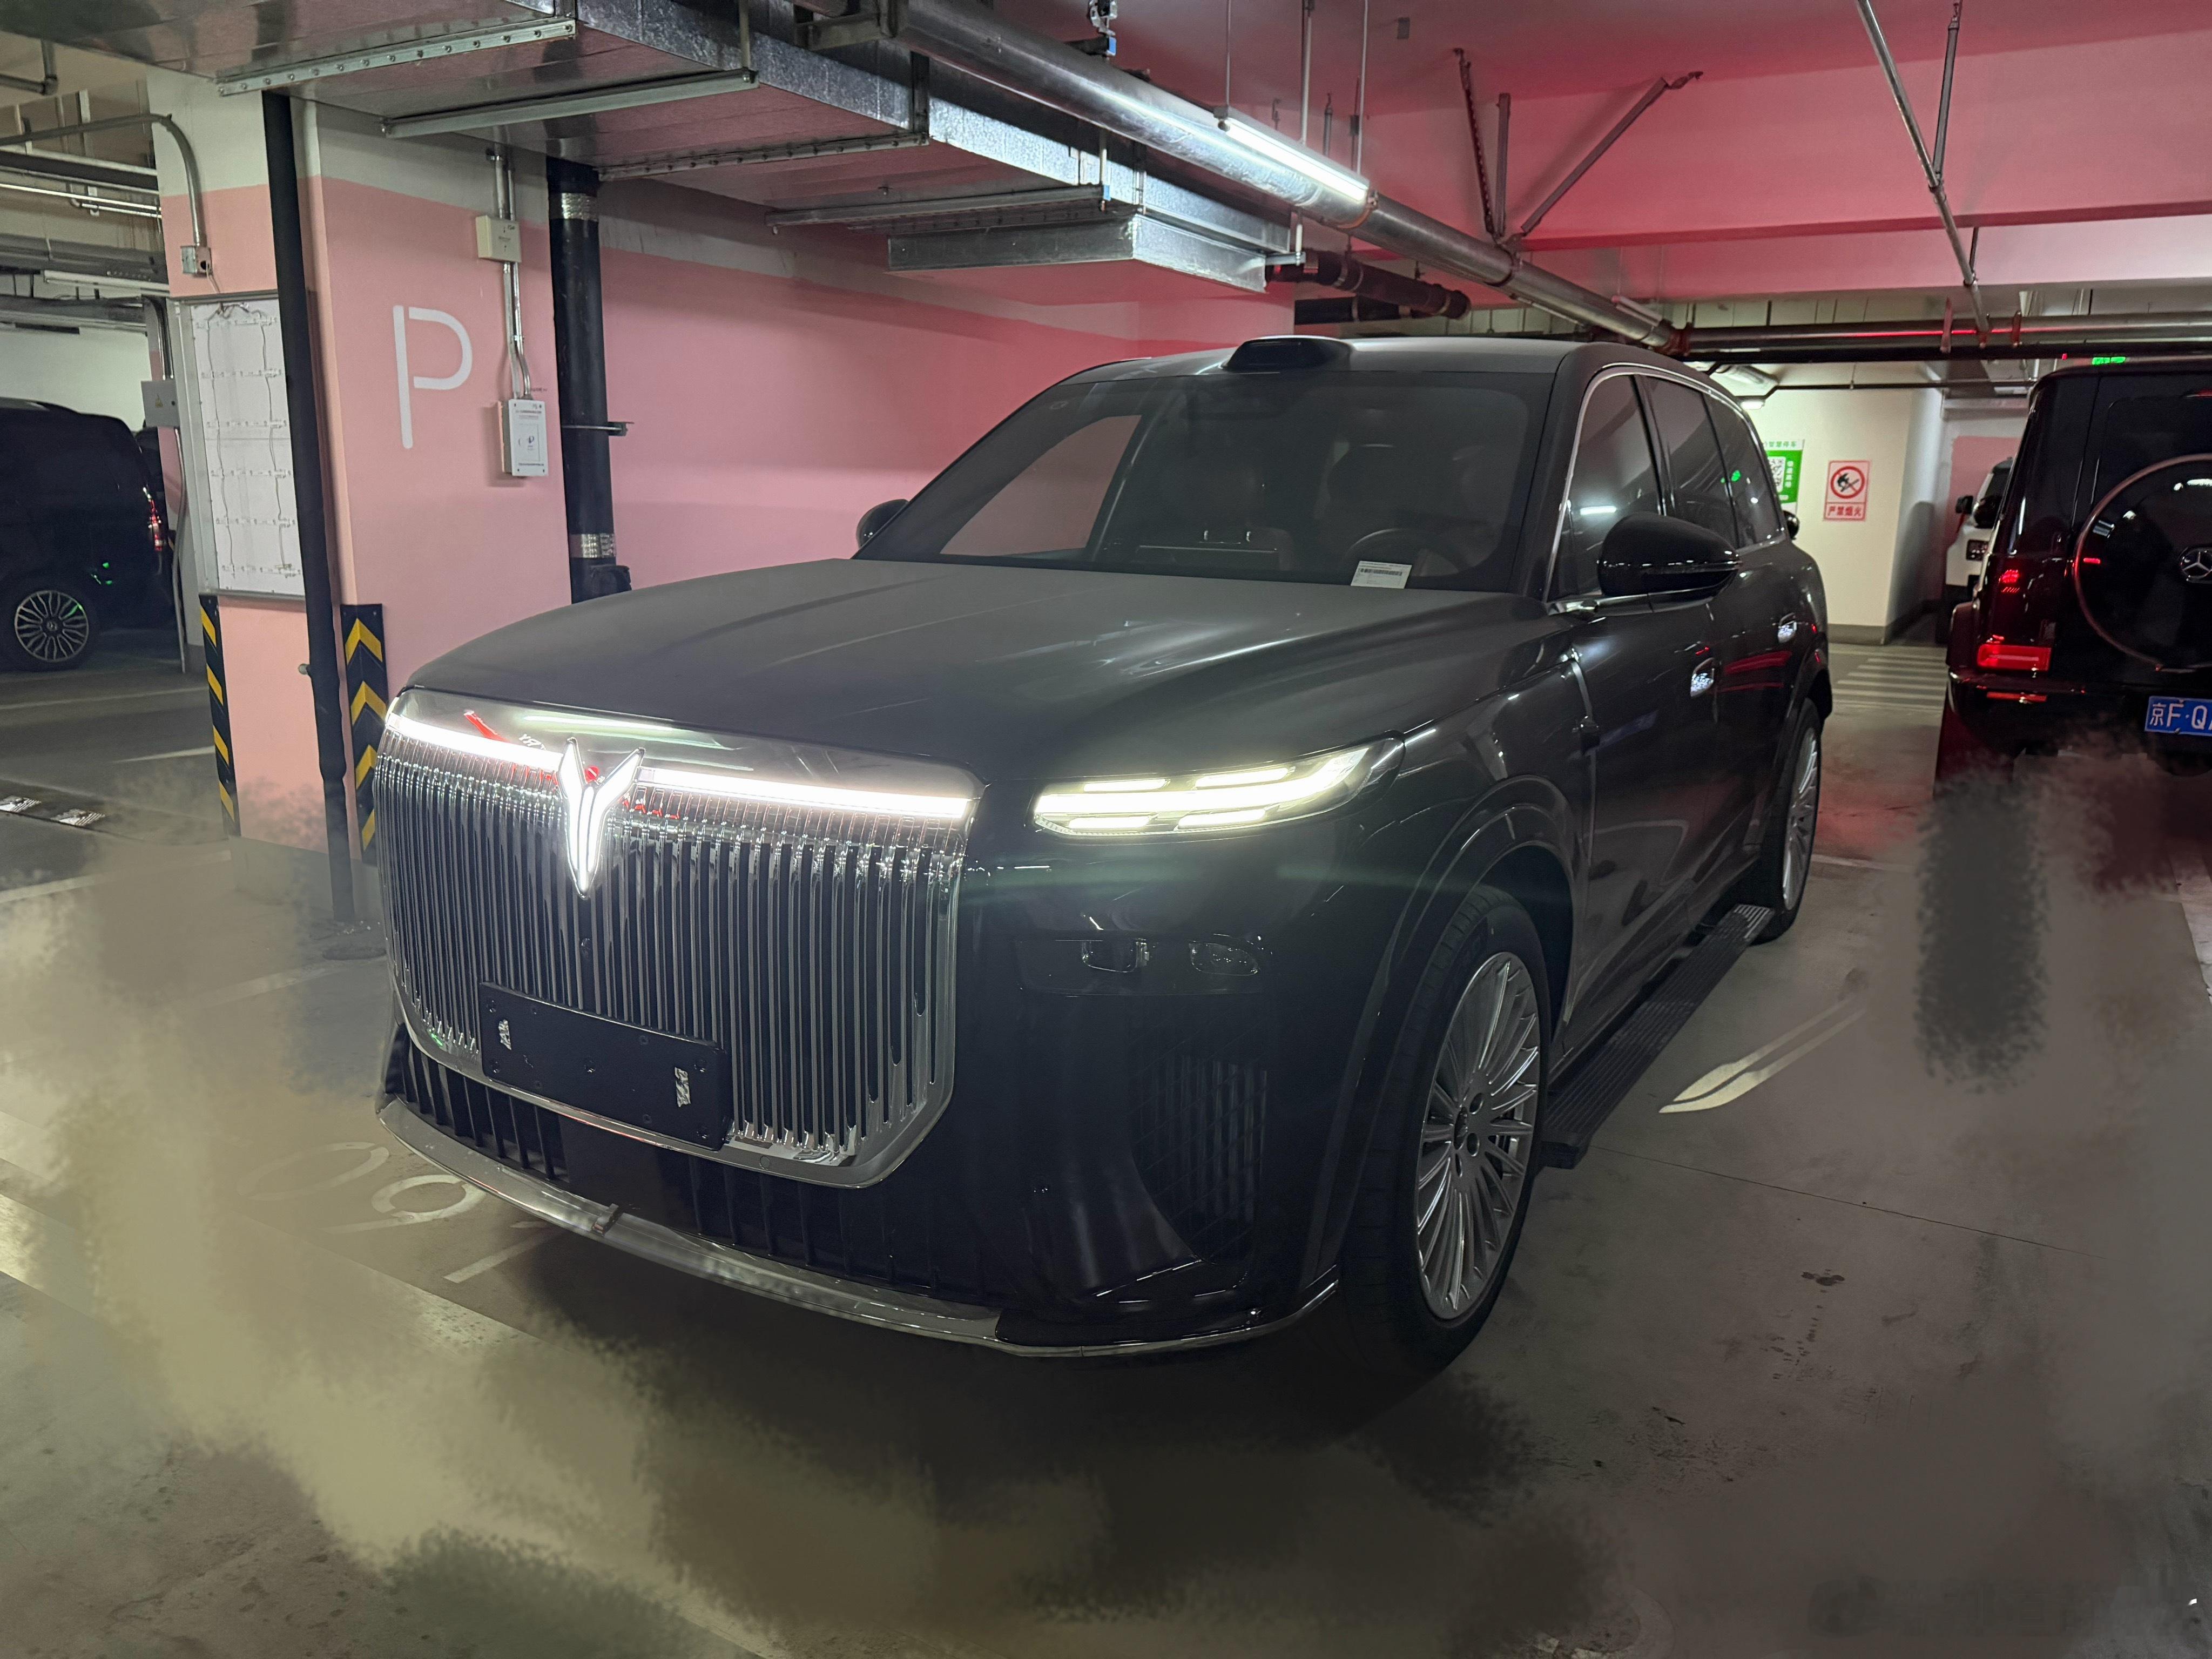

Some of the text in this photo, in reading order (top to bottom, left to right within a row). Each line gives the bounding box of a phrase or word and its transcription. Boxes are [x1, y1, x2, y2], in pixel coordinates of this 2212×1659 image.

[393, 305, 473, 449] P
[1828, 506, 1862, 516] 严禁烟火
[2149, 703, 2212, 731] 京F·Q
